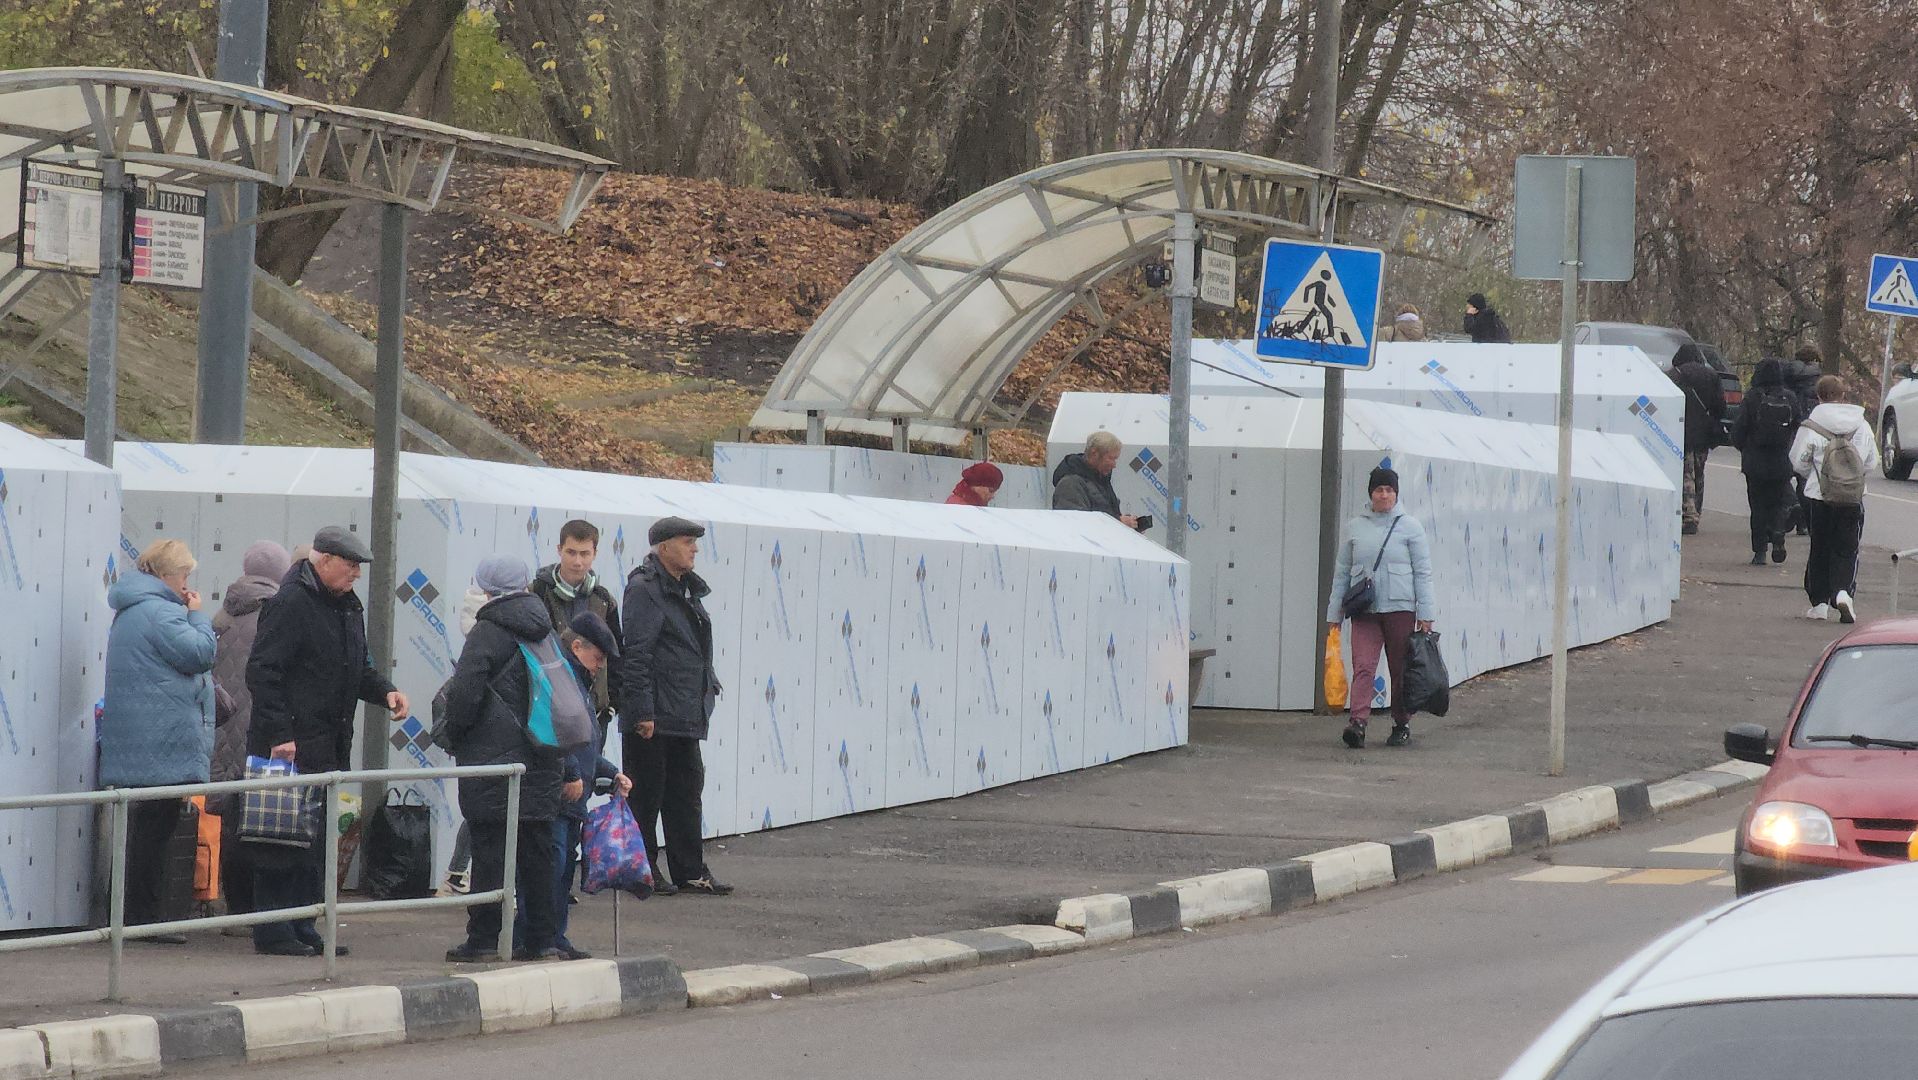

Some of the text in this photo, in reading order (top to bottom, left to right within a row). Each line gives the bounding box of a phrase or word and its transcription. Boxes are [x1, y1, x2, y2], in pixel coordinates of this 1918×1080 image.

[159, 192, 199, 214] ПЕРРОН
[1638, 410, 1684, 461] GROSSBON
[1141, 466, 1200, 532] GROSND
